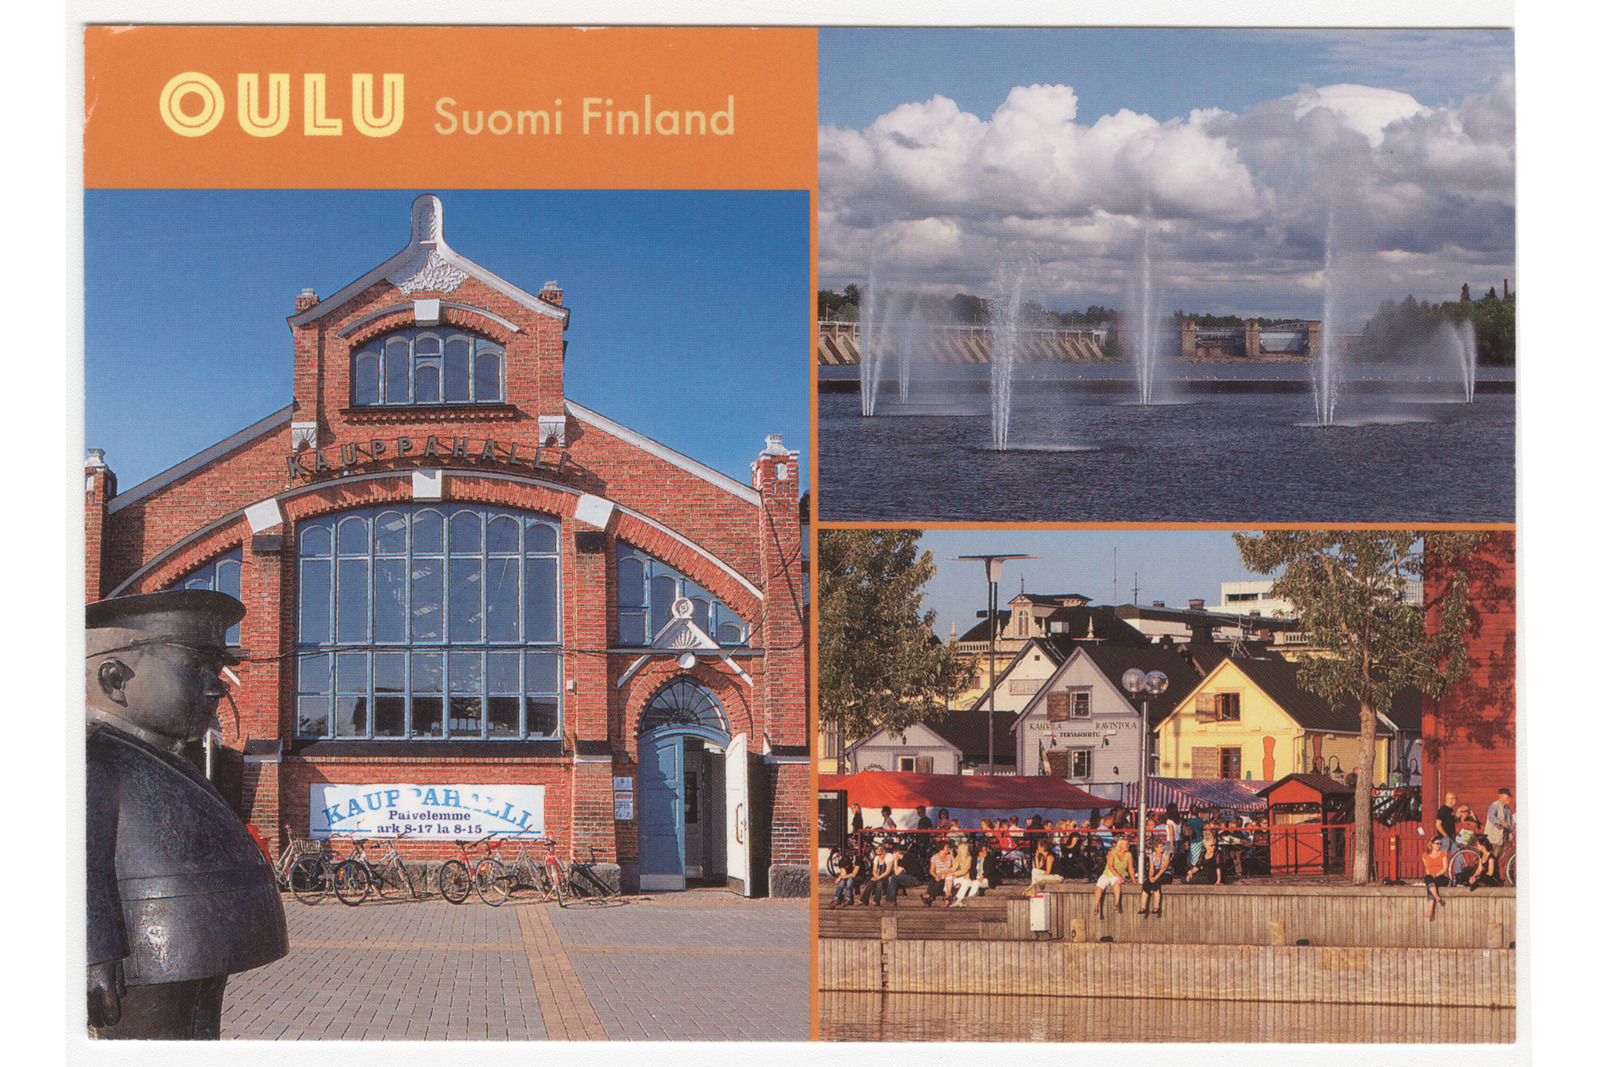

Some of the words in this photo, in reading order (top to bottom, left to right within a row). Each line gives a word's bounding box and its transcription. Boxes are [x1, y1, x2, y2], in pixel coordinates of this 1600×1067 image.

[159, 71, 405, 138] OULU
[433, 97, 563, 136] Suomi
[581, 94, 736, 136] Finland
[286, 435, 570, 478] KAUPPAHALLI
[1029, 722, 1062, 731] KAHVILA
[1095, 721, 1137, 730] RAVINTOLA
[322, 788, 533, 830] KAUPAHLI
[377, 823, 400, 834] ark
[404, 824, 433, 834] 8-17
[436, 823, 450, 834] la
[453, 824, 483, 834] 8-15
